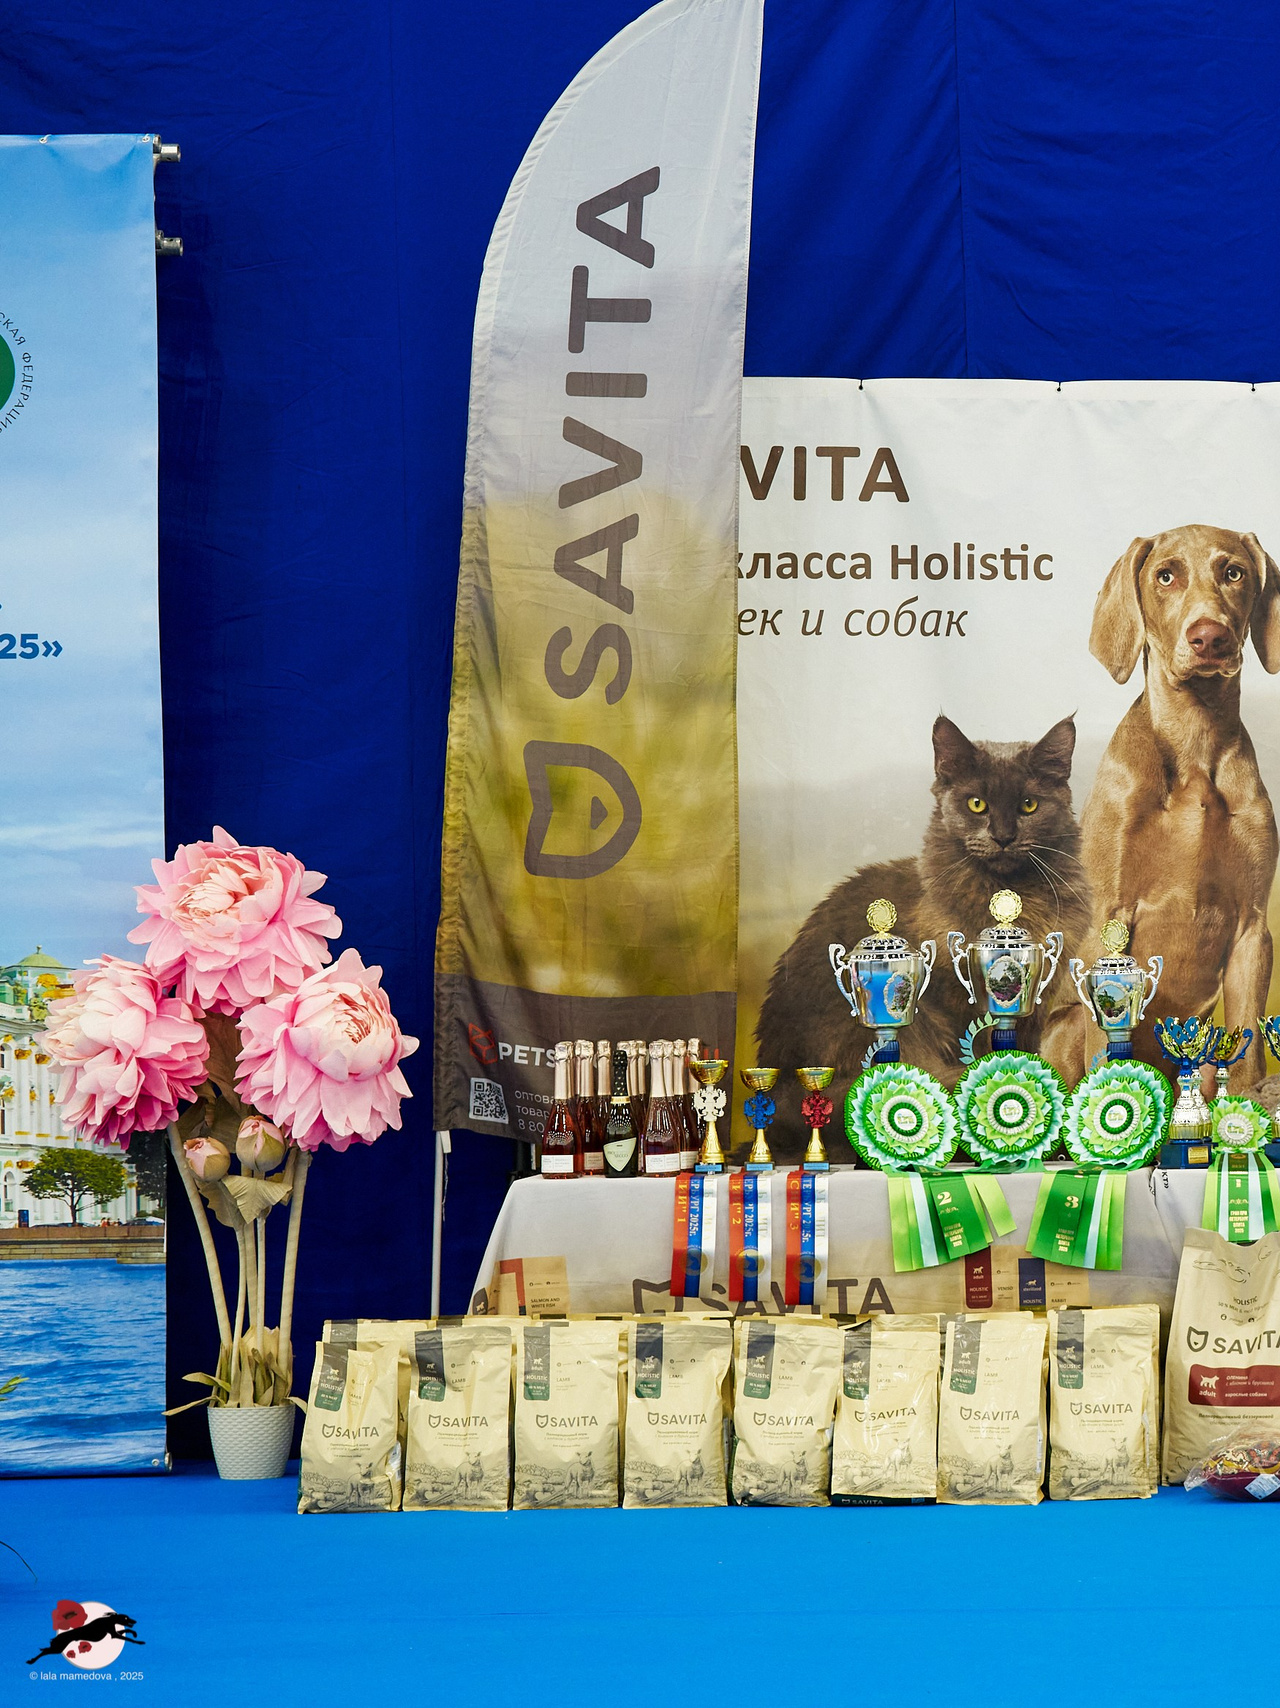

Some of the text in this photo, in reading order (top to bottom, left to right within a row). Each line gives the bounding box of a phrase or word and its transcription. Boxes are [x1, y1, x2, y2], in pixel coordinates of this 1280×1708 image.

[0, 352, 33, 433] ФЕДЕРАЦИ
[544, 166, 660, 706] SAVITA
[891, 542, 1054, 581] Holistic
[801, 608, 825, 637] и
[844, 595, 968, 637] собак
[937, 1191, 952, 1206] 2
[1064, 1195, 1079, 1209] 3
[1199, 1389, 1216, 1397] adult
[869, 1407, 917, 1421] SAVITA
[1085, 1403, 1133, 1414] SAVITA
[442, 1416, 488, 1427] SAVITA
[661, 1413, 707, 1425] SAVITA
[767, 1416, 814, 1426] SAVITA
[973, 1410, 1020, 1421] SAVITA
[550, 1416, 598, 1428] SAVITA
[335, 1427, 379, 1439] SAVITA
